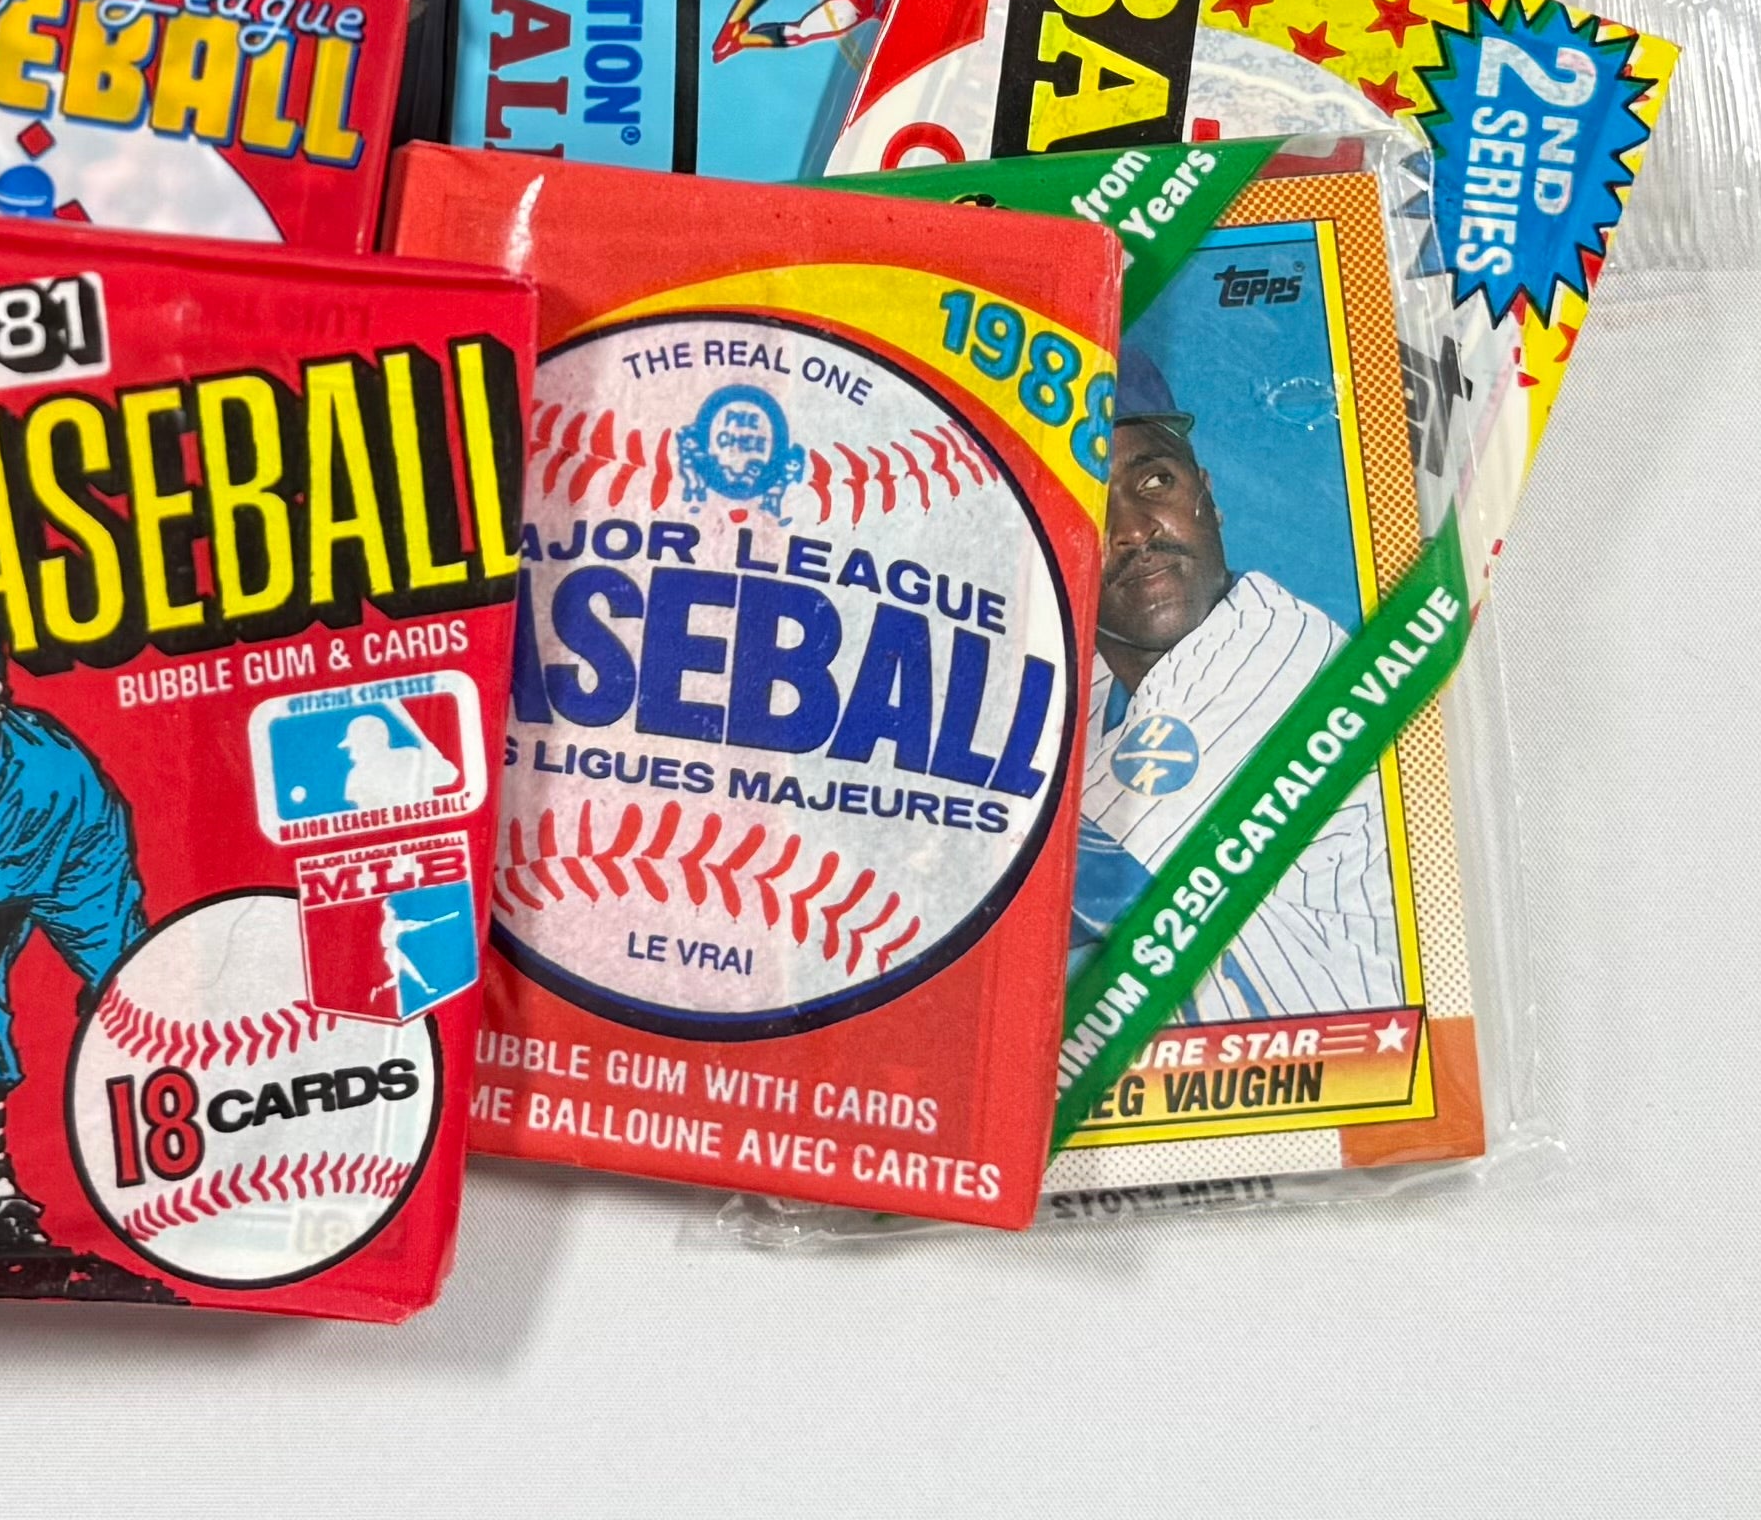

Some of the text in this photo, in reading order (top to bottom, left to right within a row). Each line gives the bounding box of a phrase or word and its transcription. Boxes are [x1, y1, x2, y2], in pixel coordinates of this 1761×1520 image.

[1476, 38, 1597, 218] 2ND
[1071, 149, 1151, 223] from
[1119, 149, 1216, 240] Years
[1457, 115, 1529, 278] SERIES
[623, 339, 874, 406] THE REAL ONE
[939, 289, 1118, 484] 1988
[520, 518, 1007, 635] AJOR LEAGUE
[118, 619, 469, 710] BUBBLE GUM & CARDS
[512, 564, 1057, 800] ASEBALL
[279, 795, 468, 842] MAJOR LEAGUE BASEBALL
[534, 739, 715, 795] LIGUES
[728, 768, 1009, 834] MAJEURES
[300, 836, 465, 871] MAJOR LEAGUE BASEBALL
[301, 848, 469, 907] MLB
[1055, 971, 1150, 1092] NIMUM
[1214, 707, 1367, 875] CATALOG
[1350, 586, 1460, 706] VALUE
[627, 930, 754, 976] LE VRAI
[475, 1029, 939, 1134] UBBLE GUM WITH CARDS
[1090, 1060, 1324, 1119] EG VAUGHN
[1131, 1028, 1321, 1070] URE STAR
[105, 1058, 421, 1190] 18 CARDS
[469, 1084, 1001, 1201] ME BALLOUNE AVEC CARTES
